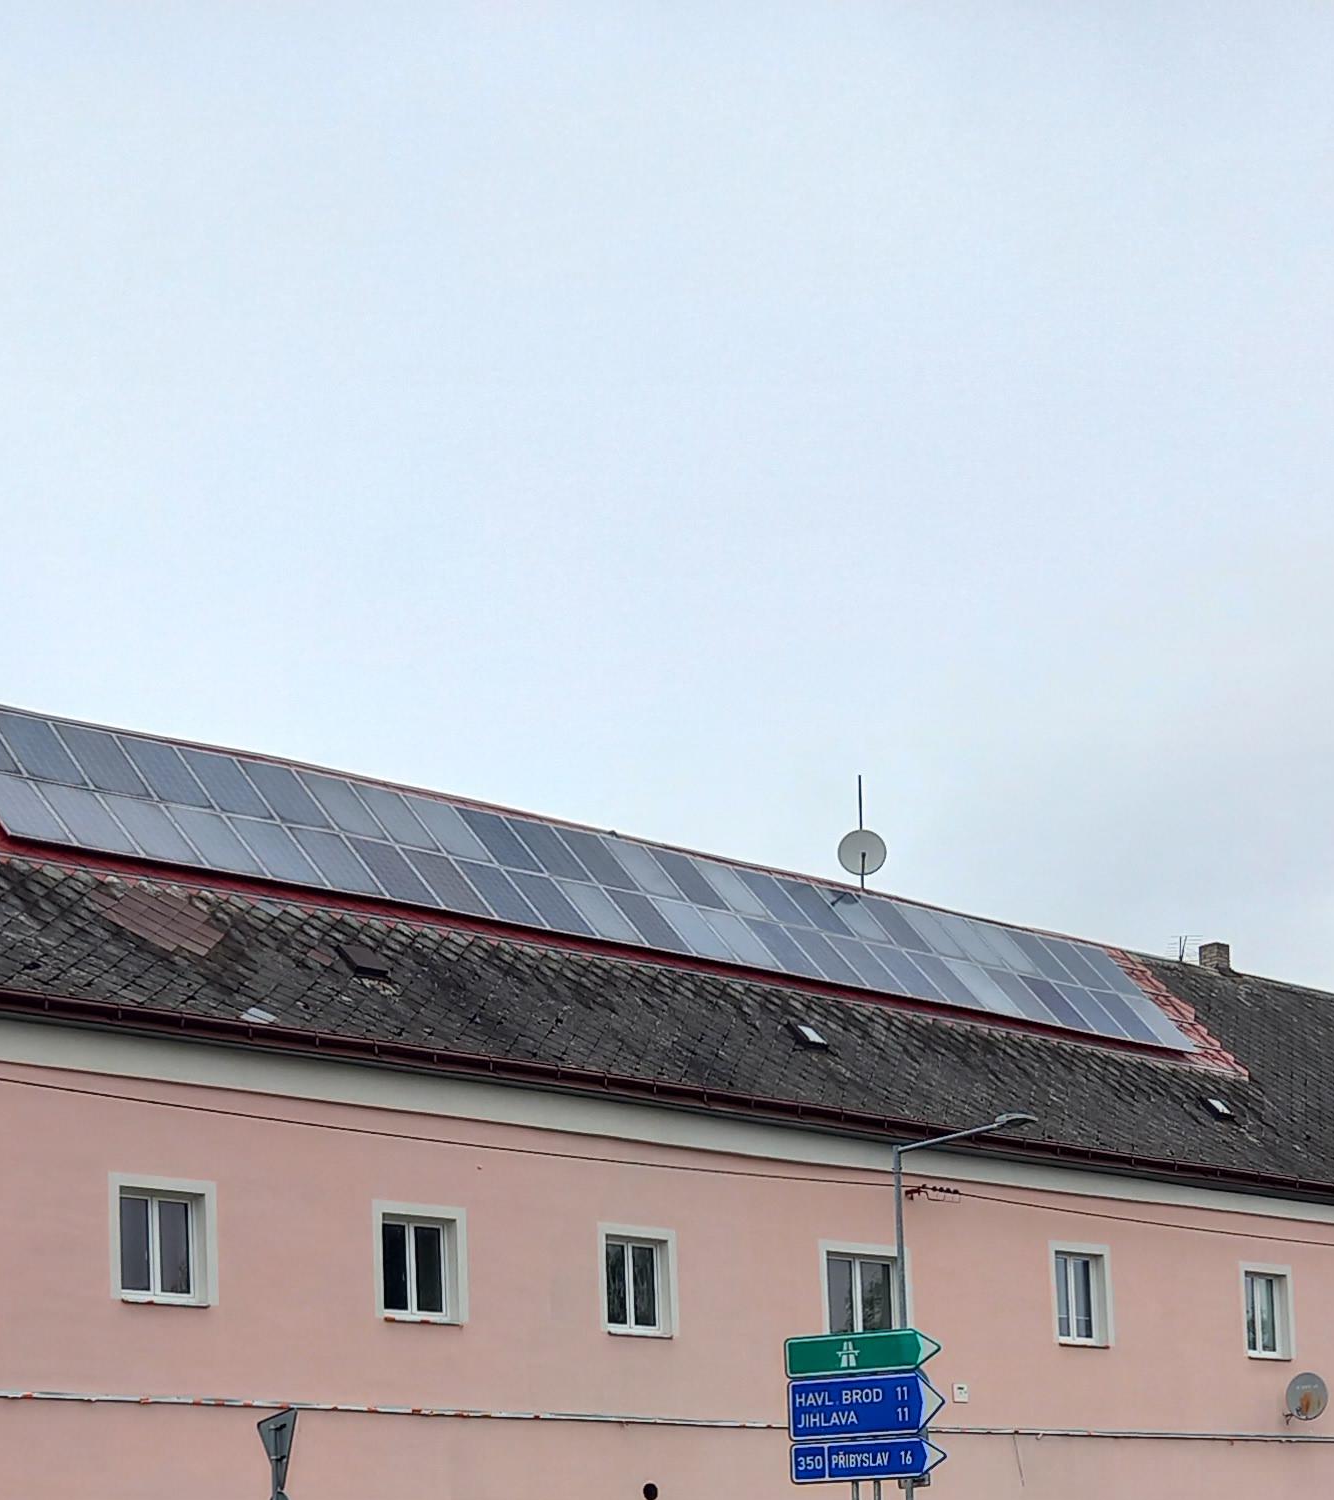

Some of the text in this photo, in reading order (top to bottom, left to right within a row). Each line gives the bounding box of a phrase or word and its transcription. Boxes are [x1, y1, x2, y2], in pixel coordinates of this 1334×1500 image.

[795, 1386, 908, 1408] HAVL. BROD 11
[797, 1407, 909, 1428] JIHLAVA 11
[797, 1450, 913, 1471] 350 PŘIBYSLAV 16
